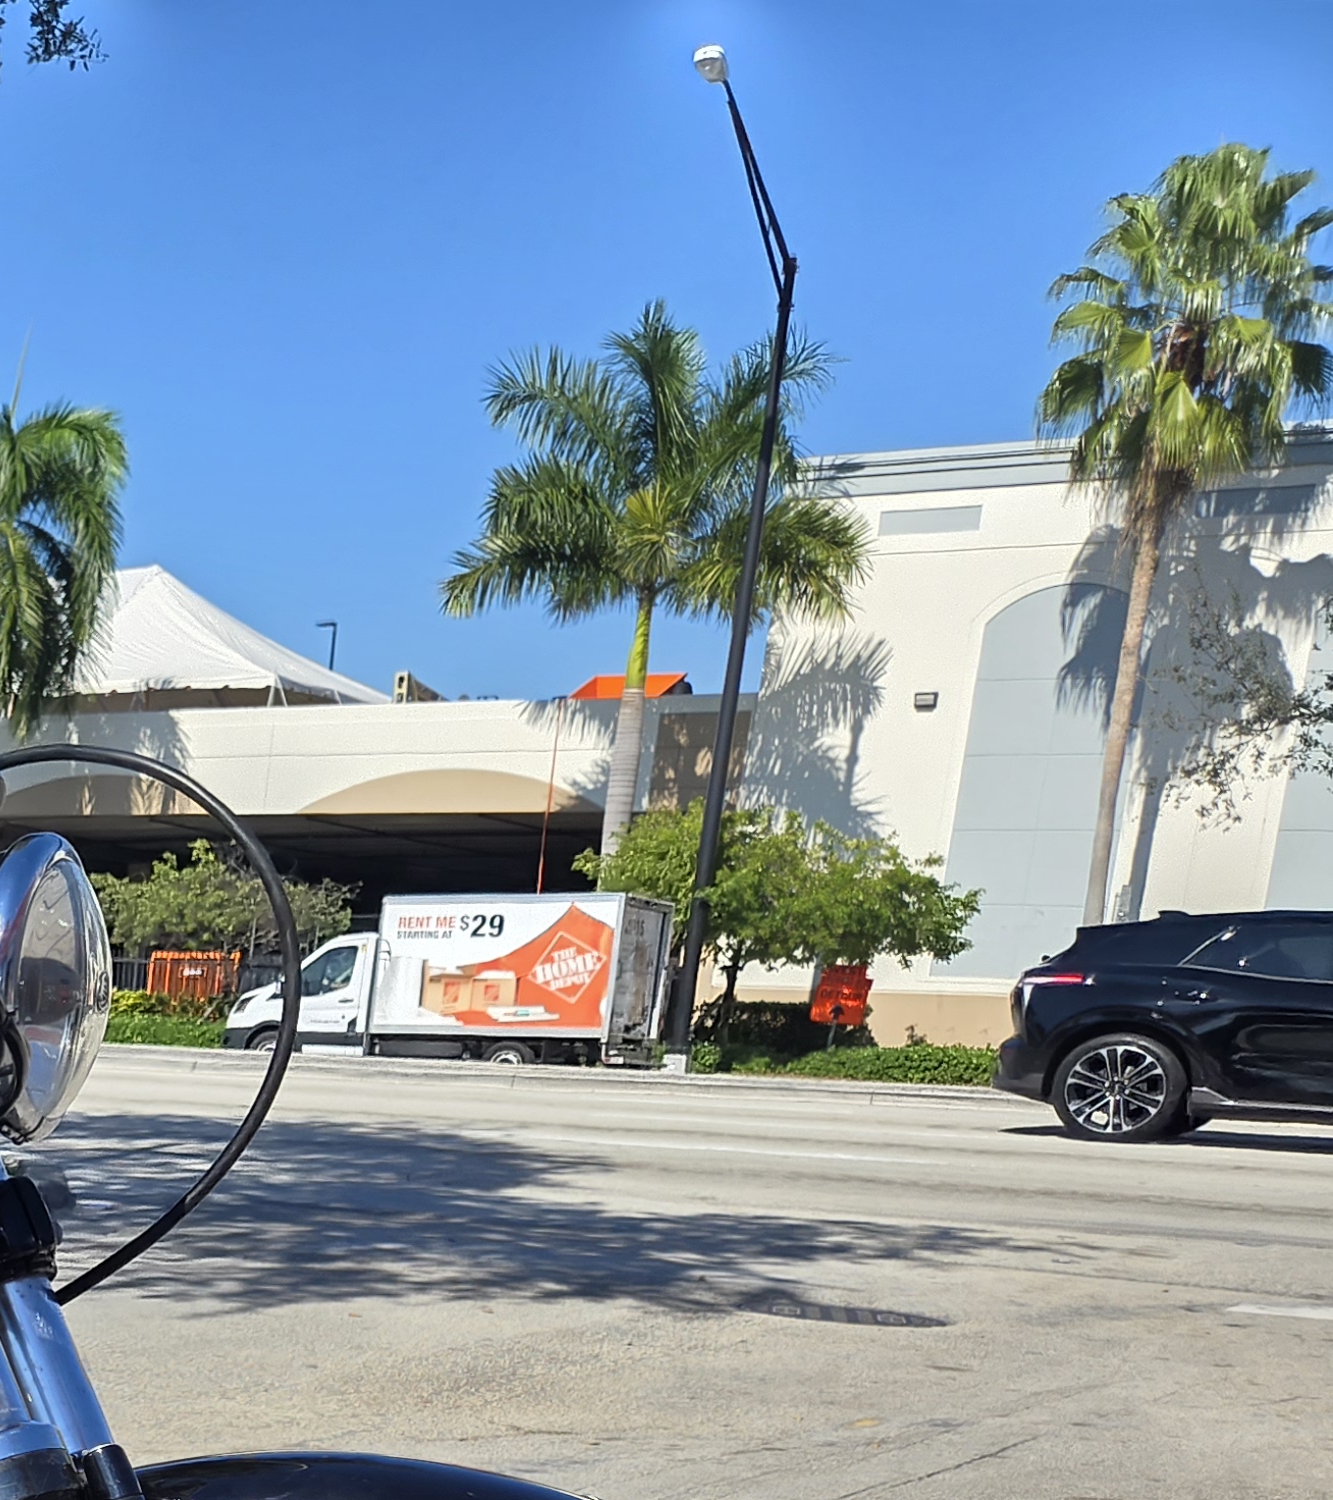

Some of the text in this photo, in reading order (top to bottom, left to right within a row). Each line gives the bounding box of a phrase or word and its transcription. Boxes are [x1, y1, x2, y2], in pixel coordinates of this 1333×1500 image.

[398, 915, 456, 929] RENT ME
[459, 913, 505, 938] $29
[396, 930, 453, 940] STARTING AT
[551, 946, 577, 962] THE
[535, 950, 601, 985] HOME
[549, 971, 592, 991] DEPOT
